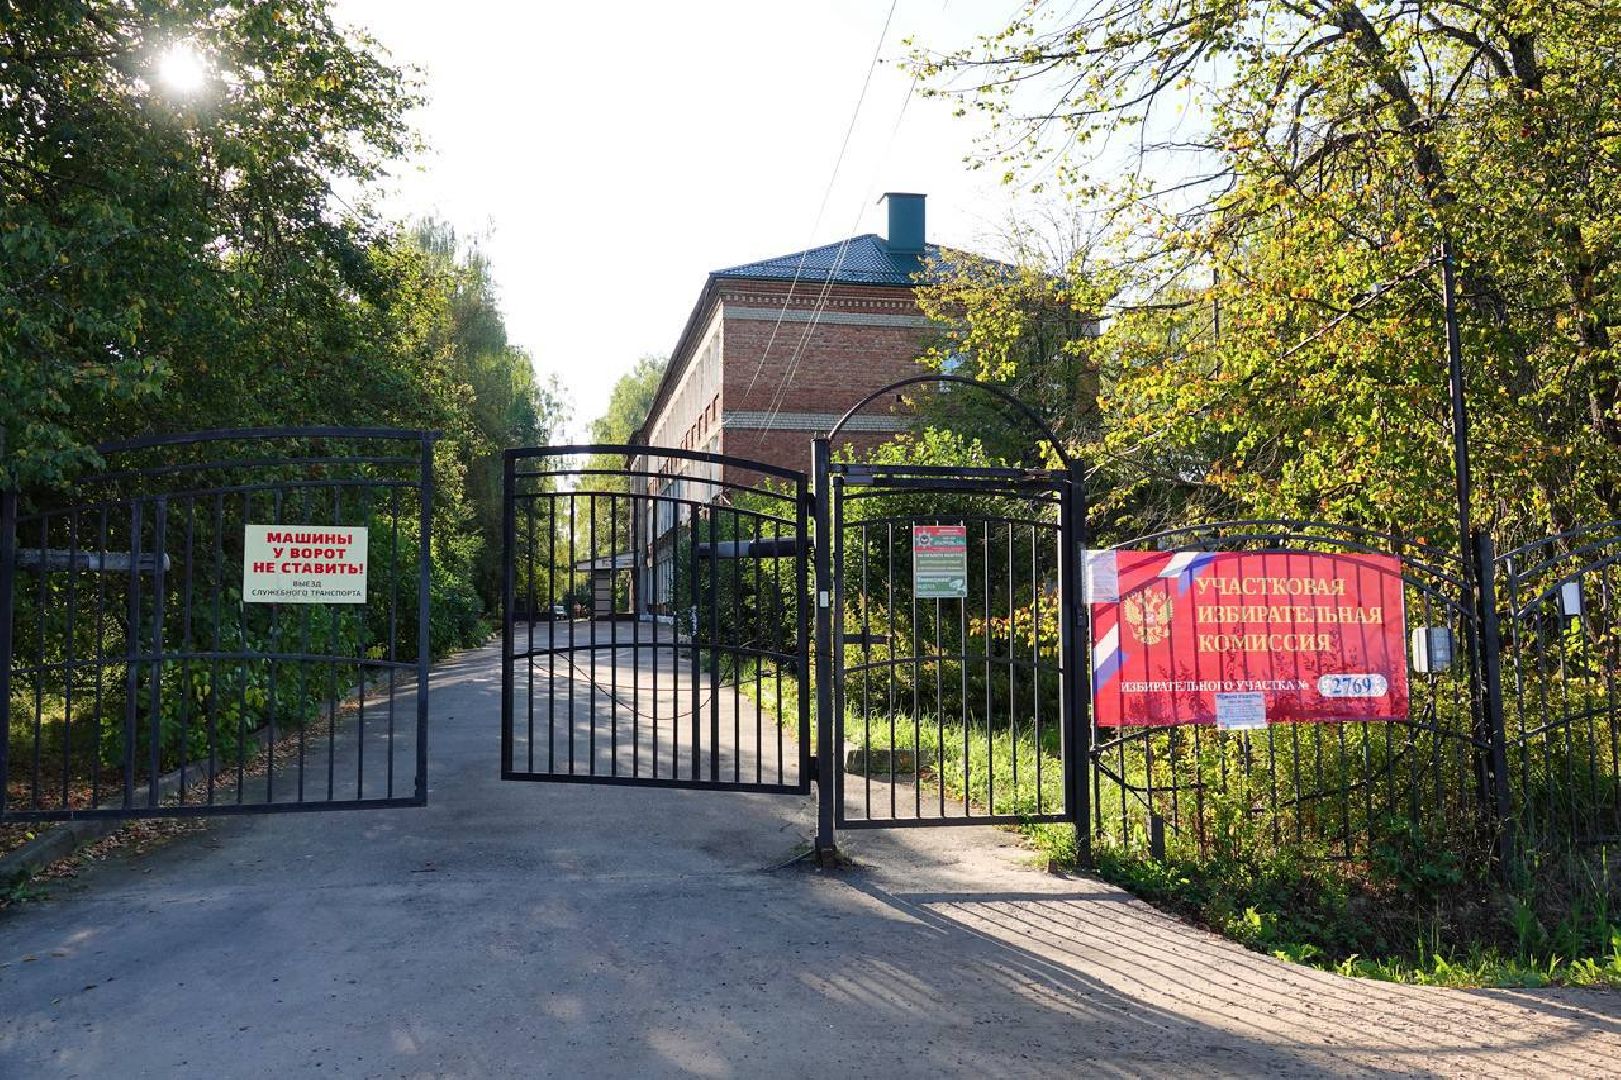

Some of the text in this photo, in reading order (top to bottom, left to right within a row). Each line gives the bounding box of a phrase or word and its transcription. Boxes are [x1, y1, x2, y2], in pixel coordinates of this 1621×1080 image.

[267, 532, 353, 544] МАШИНЫ
[272, 547, 346, 559] У ВОРОТ
[253, 562, 364, 574] НЕ СТАВИТЬ!
[251, 589, 361, 597] СЛУЖЕБНОГО ТРАНСПОРТА
[1194, 577, 1346, 596] УЧАСТКОВАЯ
[1197, 606, 1383, 625] ИЗБИРАТЕЛЬНАЯ
[1198, 634, 1332, 653] КОМИССИЯ
[1121, 680, 1233, 693] ИЗБИРАТЕЛЬНОГО
[1236, 679, 1296, 691] УЧАСТКА
[1332, 677, 1372, 694] 2769
